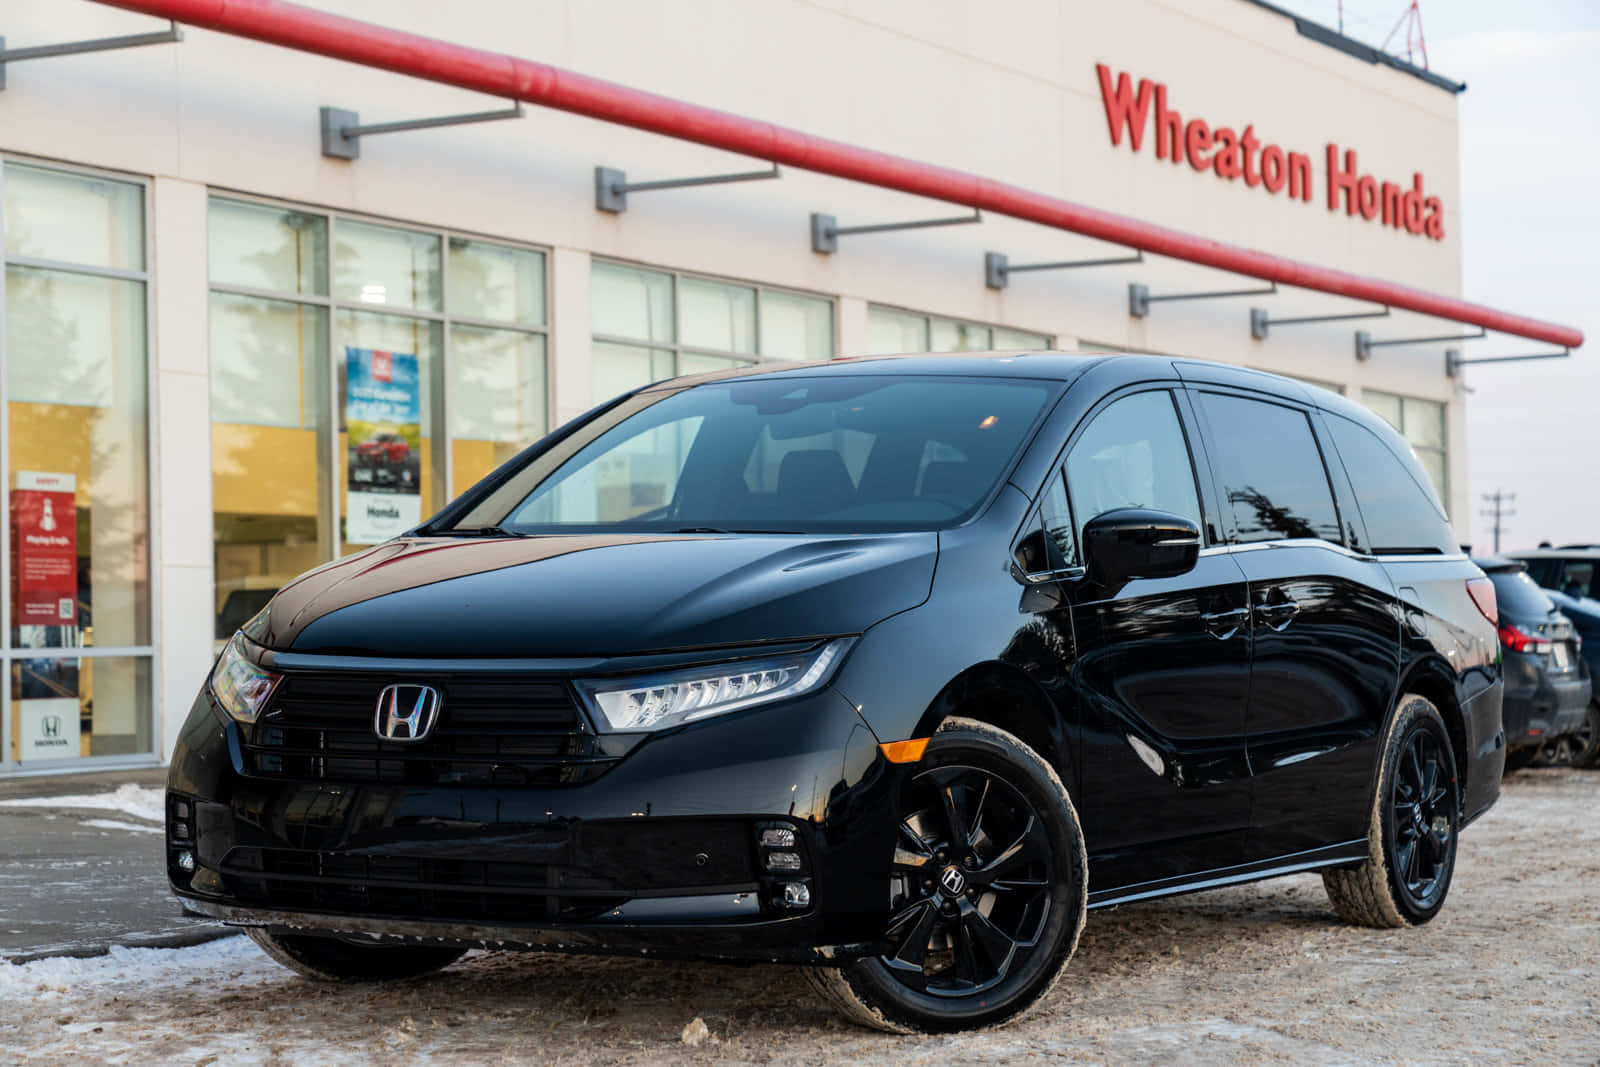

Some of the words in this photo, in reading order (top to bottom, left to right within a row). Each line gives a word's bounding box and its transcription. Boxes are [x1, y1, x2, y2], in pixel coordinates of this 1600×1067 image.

[1095, 62, 1313, 203] Wheaton
[1326, 143, 1445, 240] Honda
[367, 505, 400, 518] Honda
